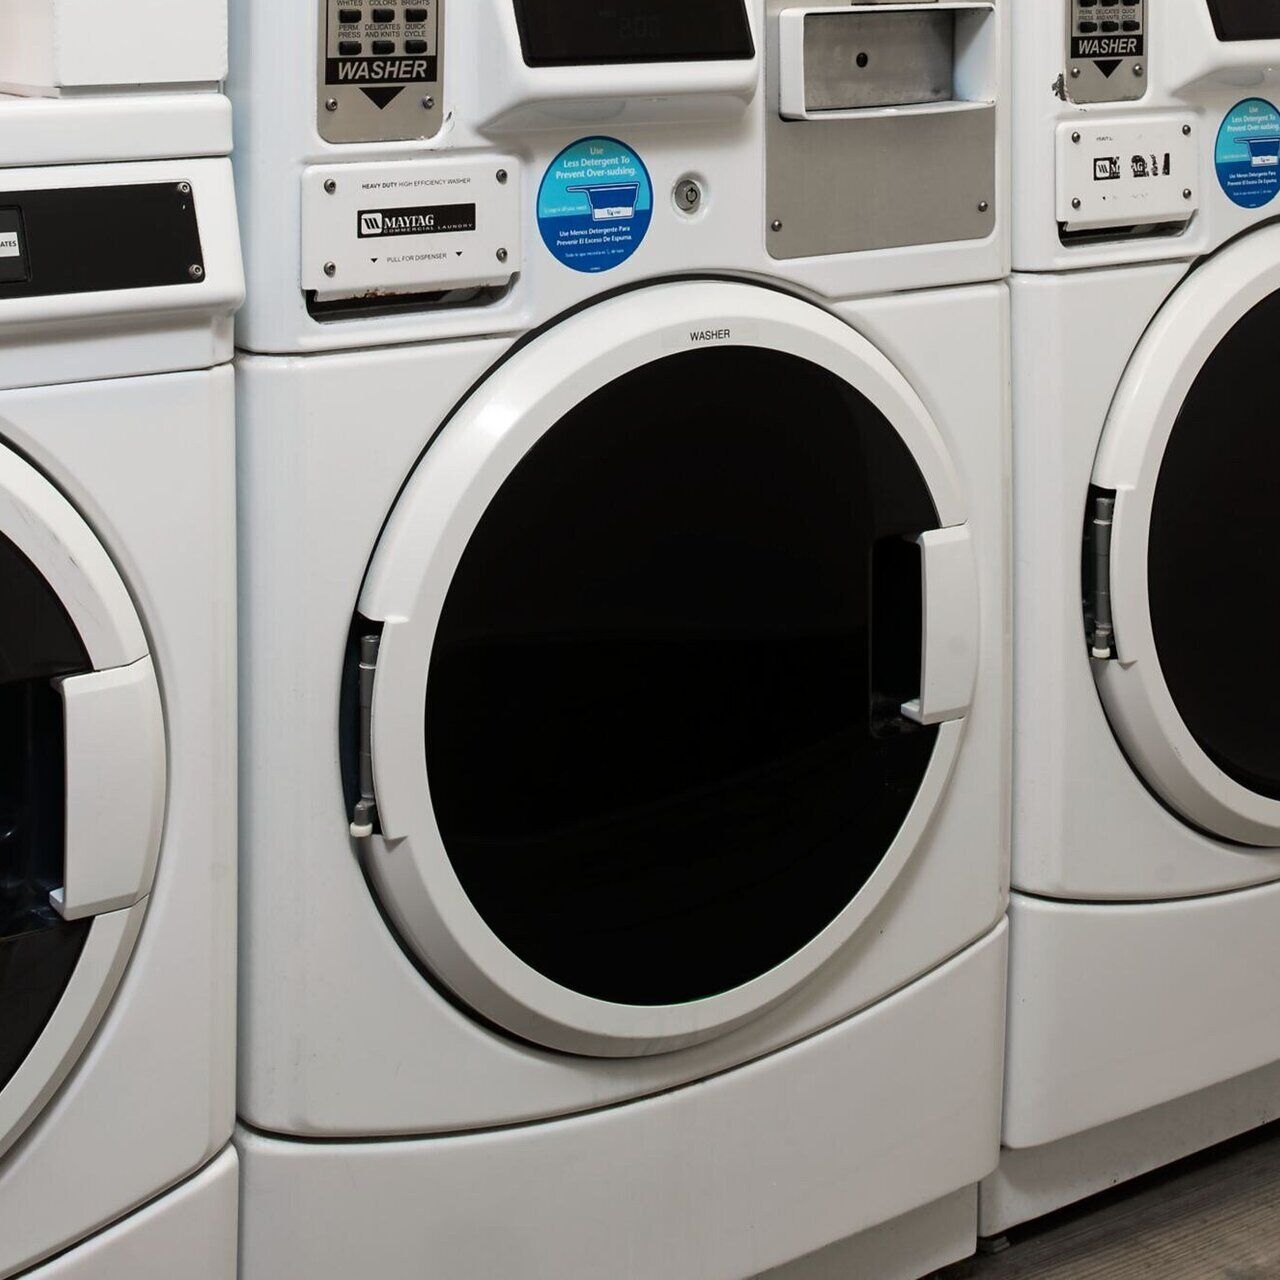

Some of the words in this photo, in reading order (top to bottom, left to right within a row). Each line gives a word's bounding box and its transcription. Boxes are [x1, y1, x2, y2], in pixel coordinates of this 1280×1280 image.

[1079, 38, 1137, 54] WASHER
[338, 60, 427, 80] WASHER
[590, 147, 604, 155] Use
[563, 160, 579, 168] Less
[581, 157, 619, 168] Detergent
[621, 156, 630, 164] To
[556, 170, 585, 179] Prevent
[413, 179, 447, 187] EFFICIENCY
[383, 214, 434, 228] MAYTAG
[588, 227, 618, 236] Detergente
[415, 253, 447, 261] DISPENSER
[690, 329, 730, 341] WASHER
